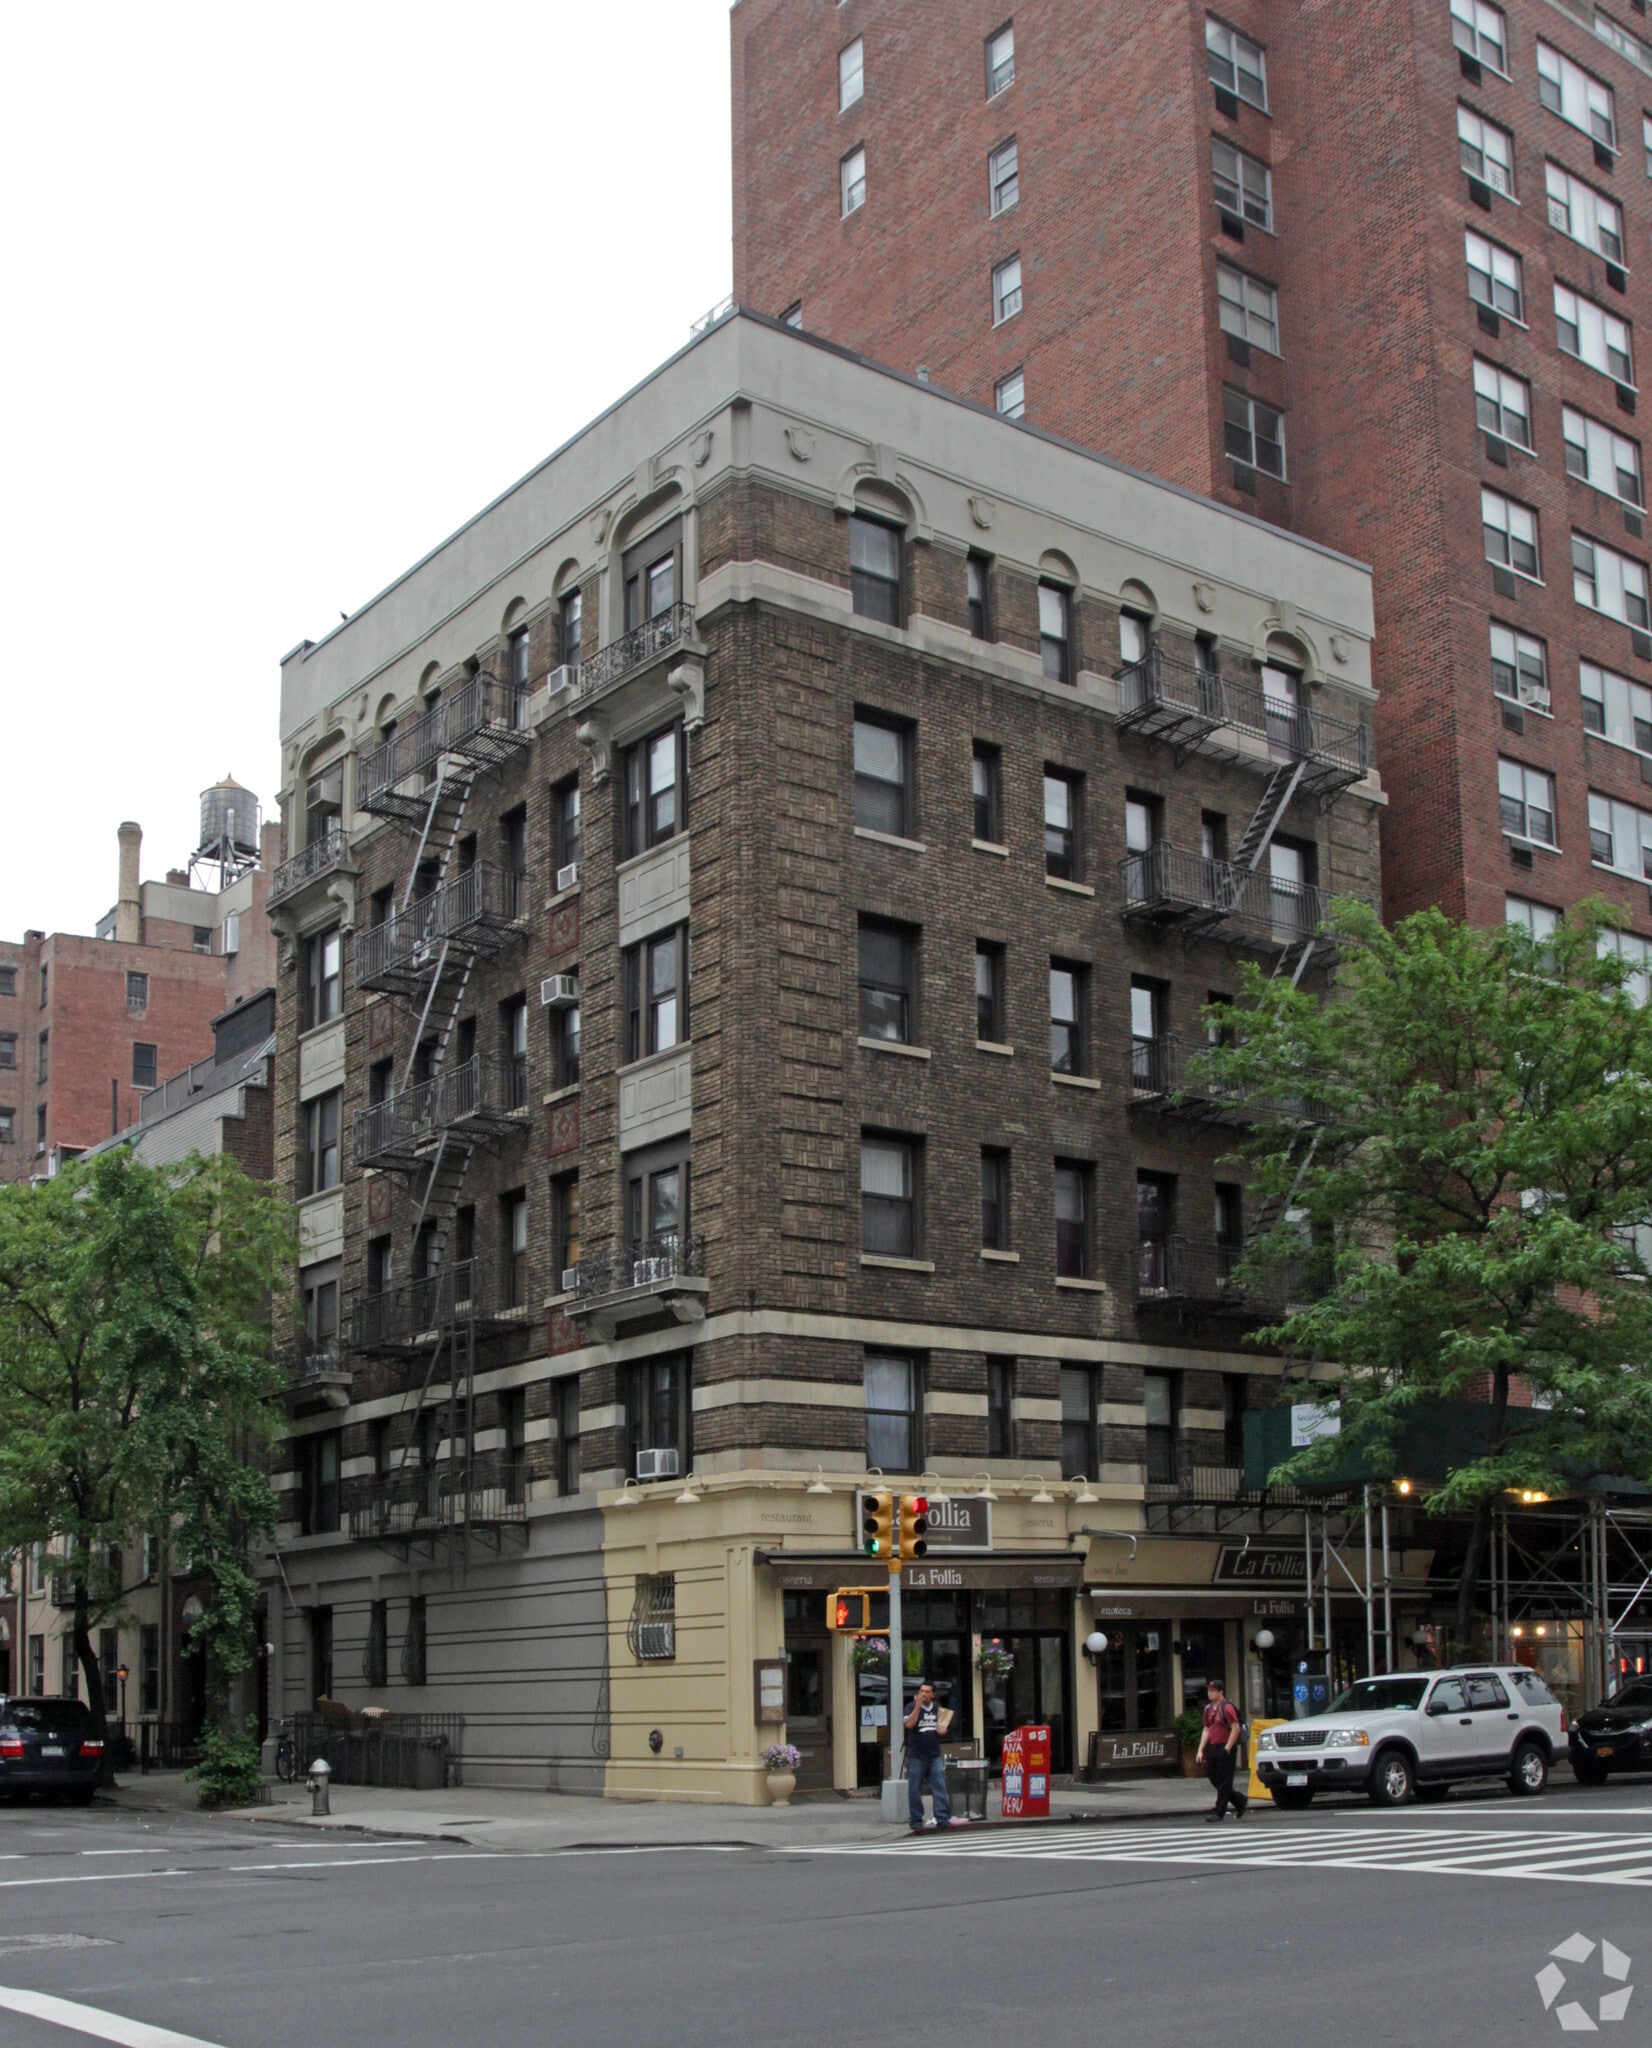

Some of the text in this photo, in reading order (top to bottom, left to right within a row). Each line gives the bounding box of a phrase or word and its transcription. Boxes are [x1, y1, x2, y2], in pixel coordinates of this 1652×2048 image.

[761, 1512, 812, 1522] restaurant
[920, 1501, 971, 1527] ollia
[1094, 1562, 1128, 1576] wine bar
[1232, 1553, 1305, 1576] La Follia
[909, 1569, 962, 1585] La Follia
[1101, 1607, 1132, 1615] enoteca
[1254, 1600, 1295, 1614] La Follia
[864, 1709, 872, 1720] A
[1113, 1742, 1164, 1757] La Follia
[1003, 1763, 1024, 1774] ANA
[1003, 1797, 1023, 1814] PERU
